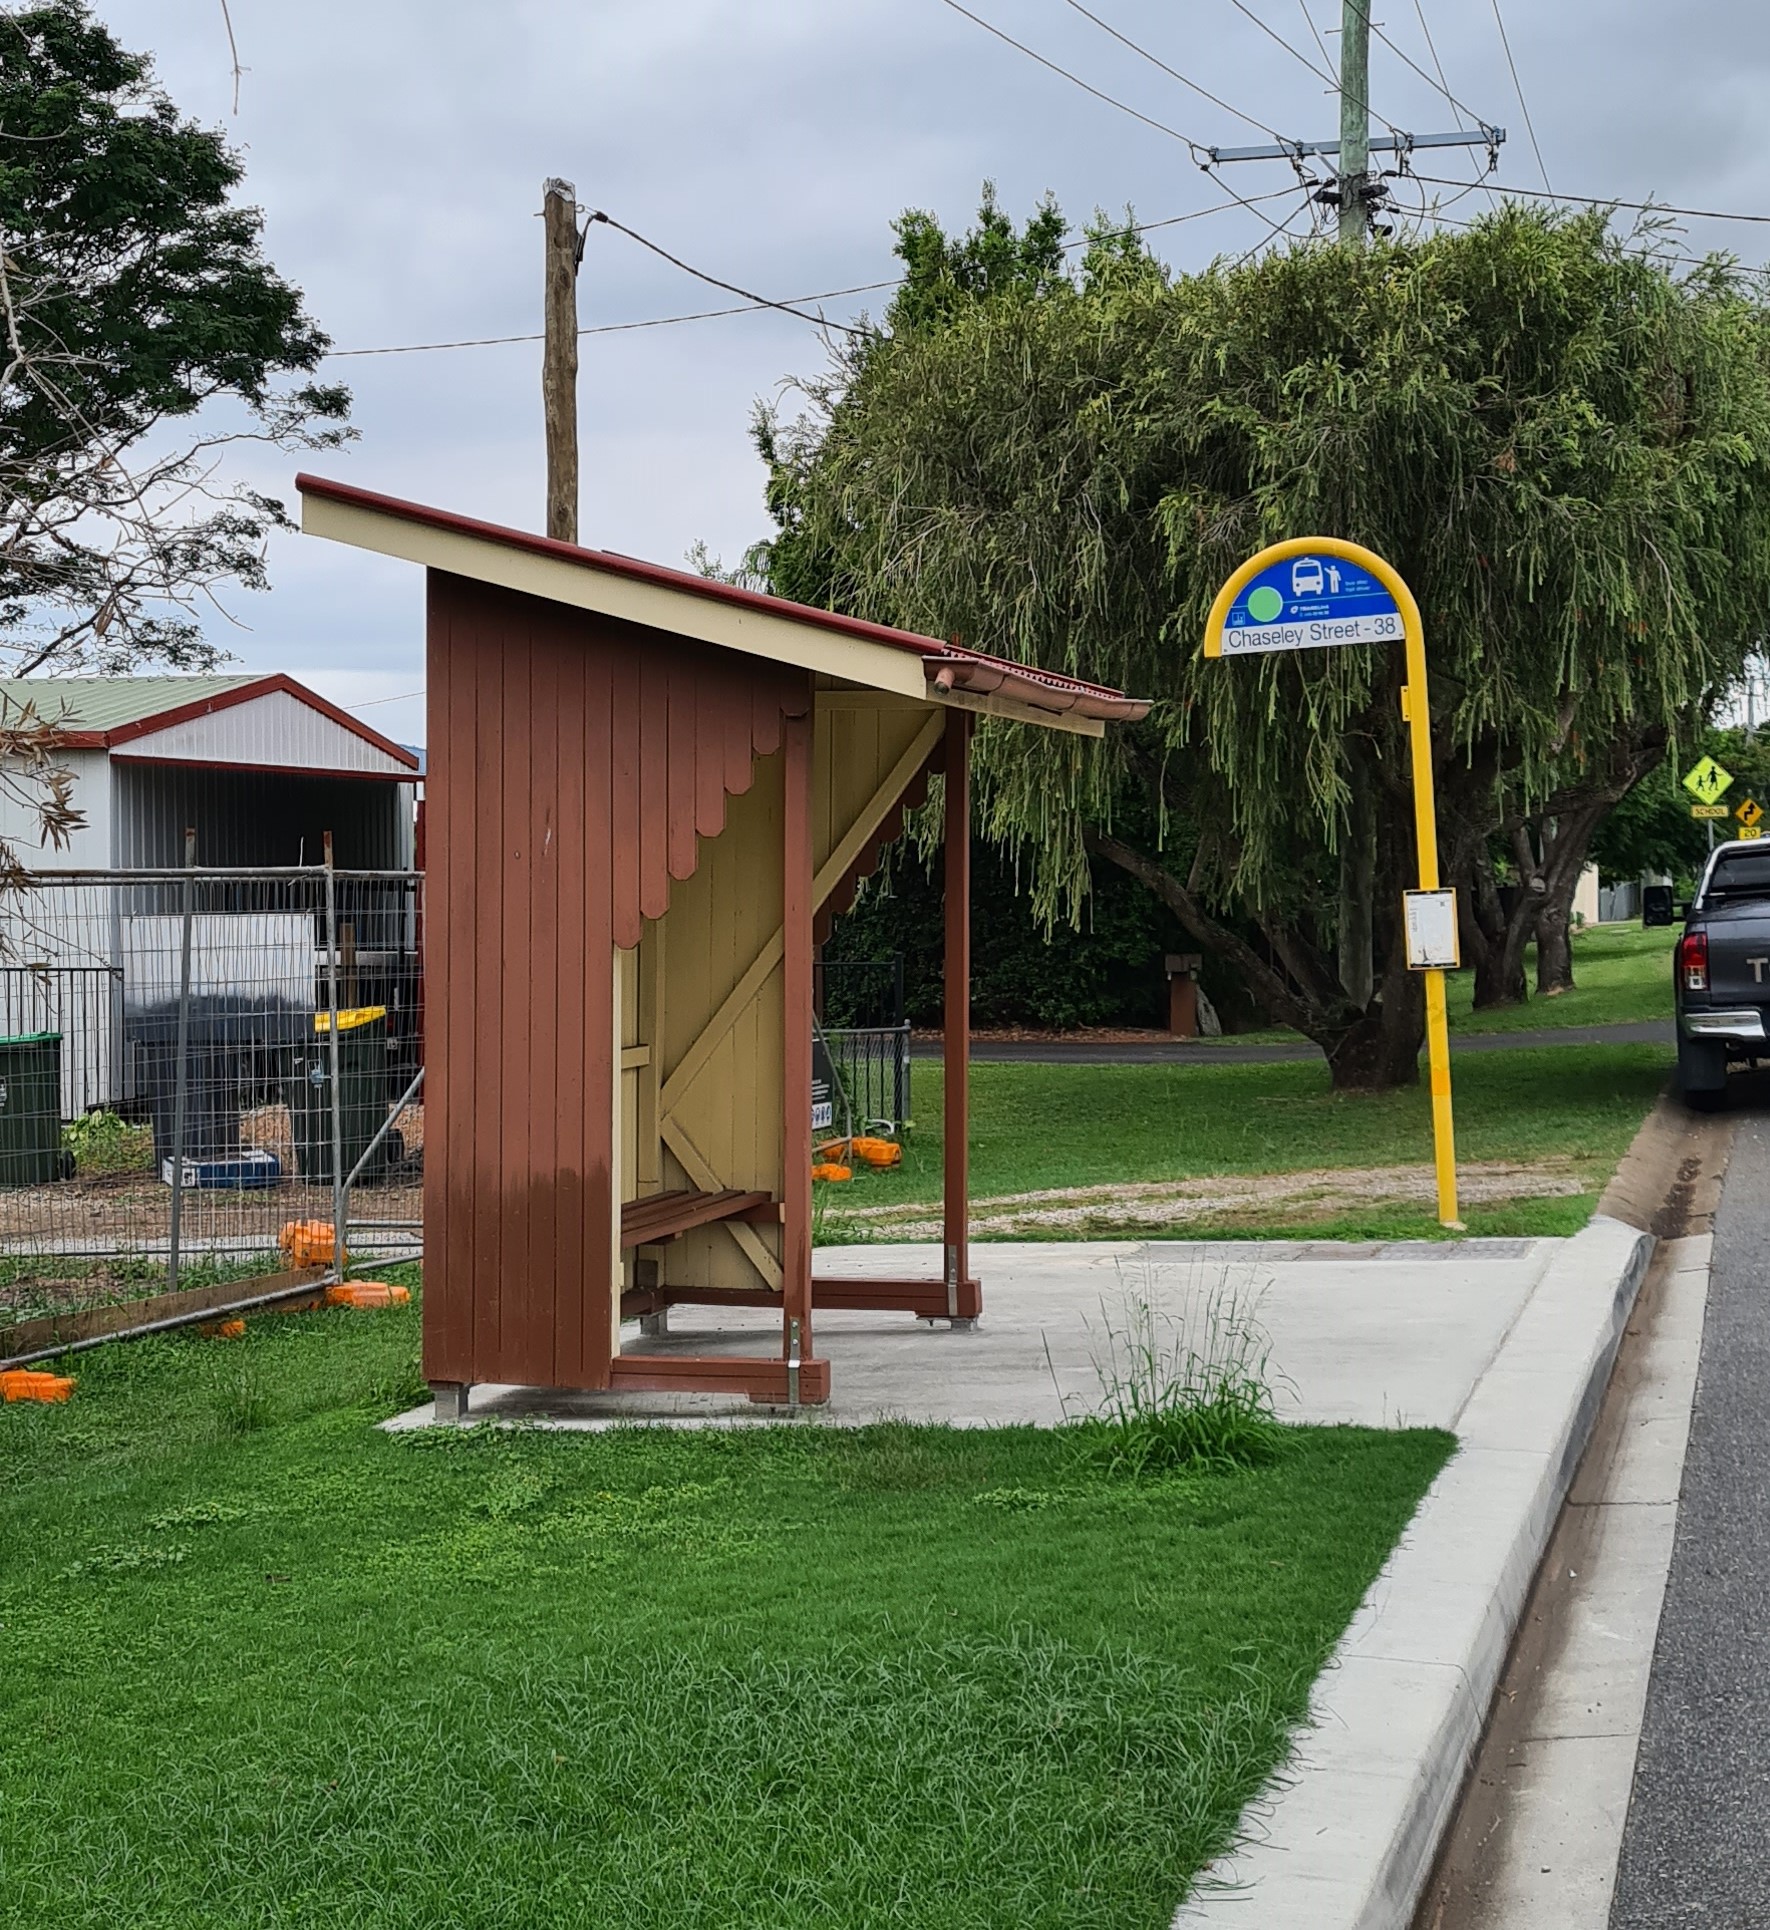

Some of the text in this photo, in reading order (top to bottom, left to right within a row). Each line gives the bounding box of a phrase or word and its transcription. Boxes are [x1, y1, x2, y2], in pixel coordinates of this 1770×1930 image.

[1228, 626, 1303, 648] Chaseley
[1310, 620, 1361, 641] Street
[1374, 617, 1396, 636] 38
[1695, 807, 1726, 816] SCHOOL
[1744, 829, 1757, 837] 20
[1746, 957, 1770, 983] T
